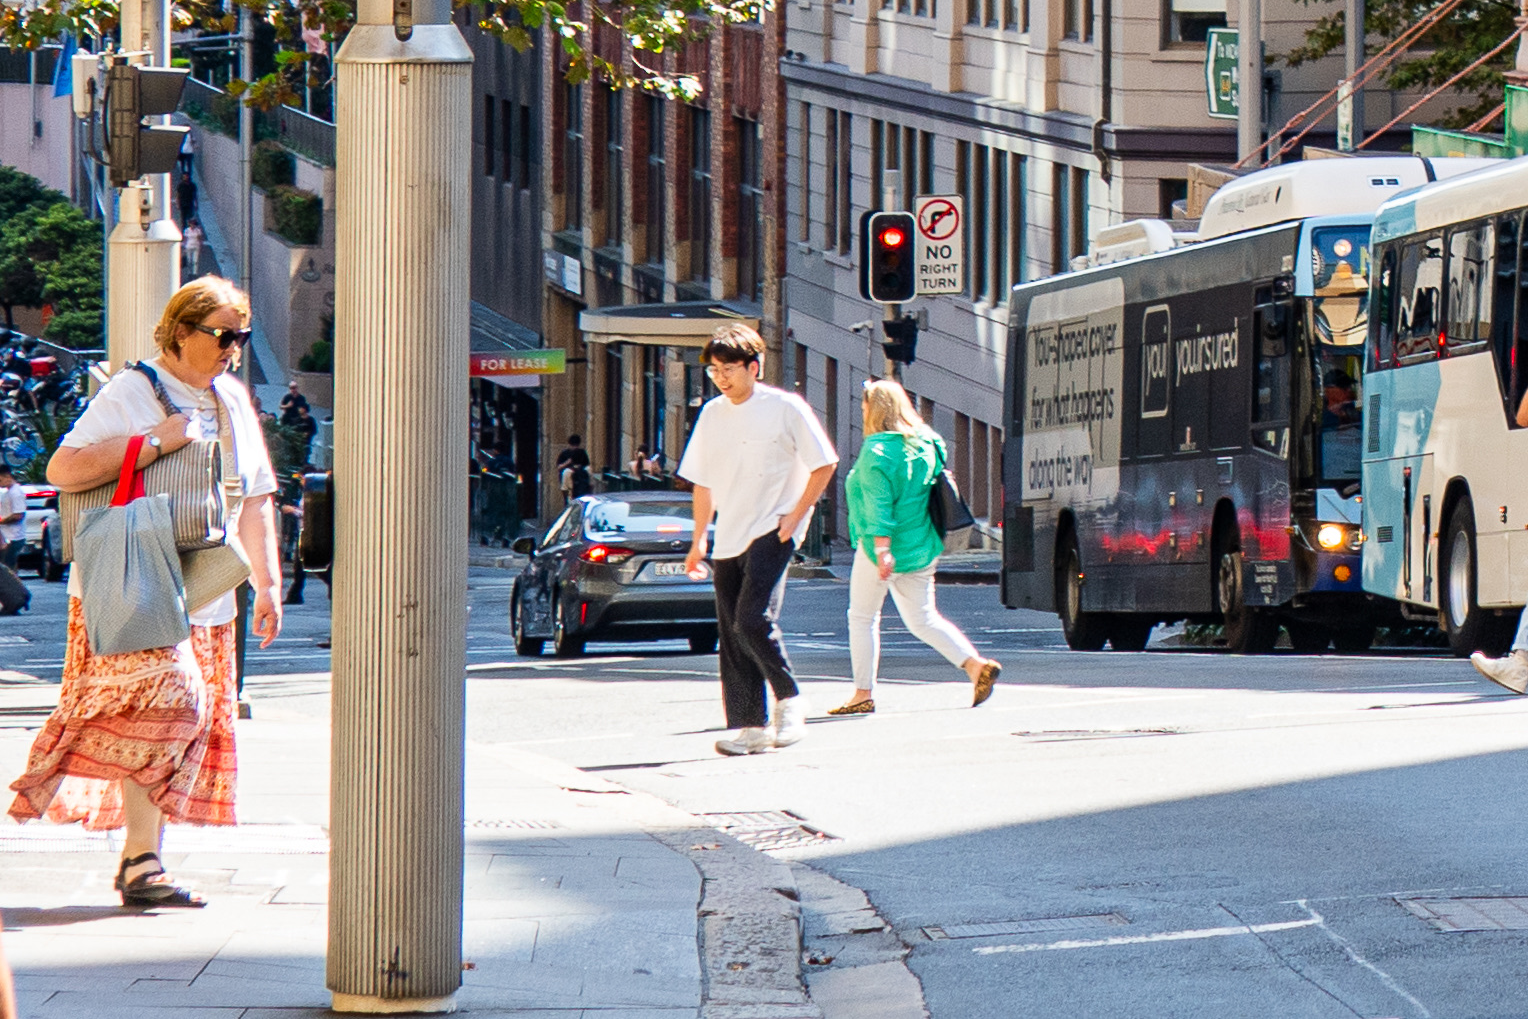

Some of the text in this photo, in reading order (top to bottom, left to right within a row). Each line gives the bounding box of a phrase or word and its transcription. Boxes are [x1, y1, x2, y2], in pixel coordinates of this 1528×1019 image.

[926, 245, 952, 260] NO
[920, 263, 958, 274] RIGHT
[921, 278, 956, 289] TURN
[480, 357, 549, 371] FOR LEASE
